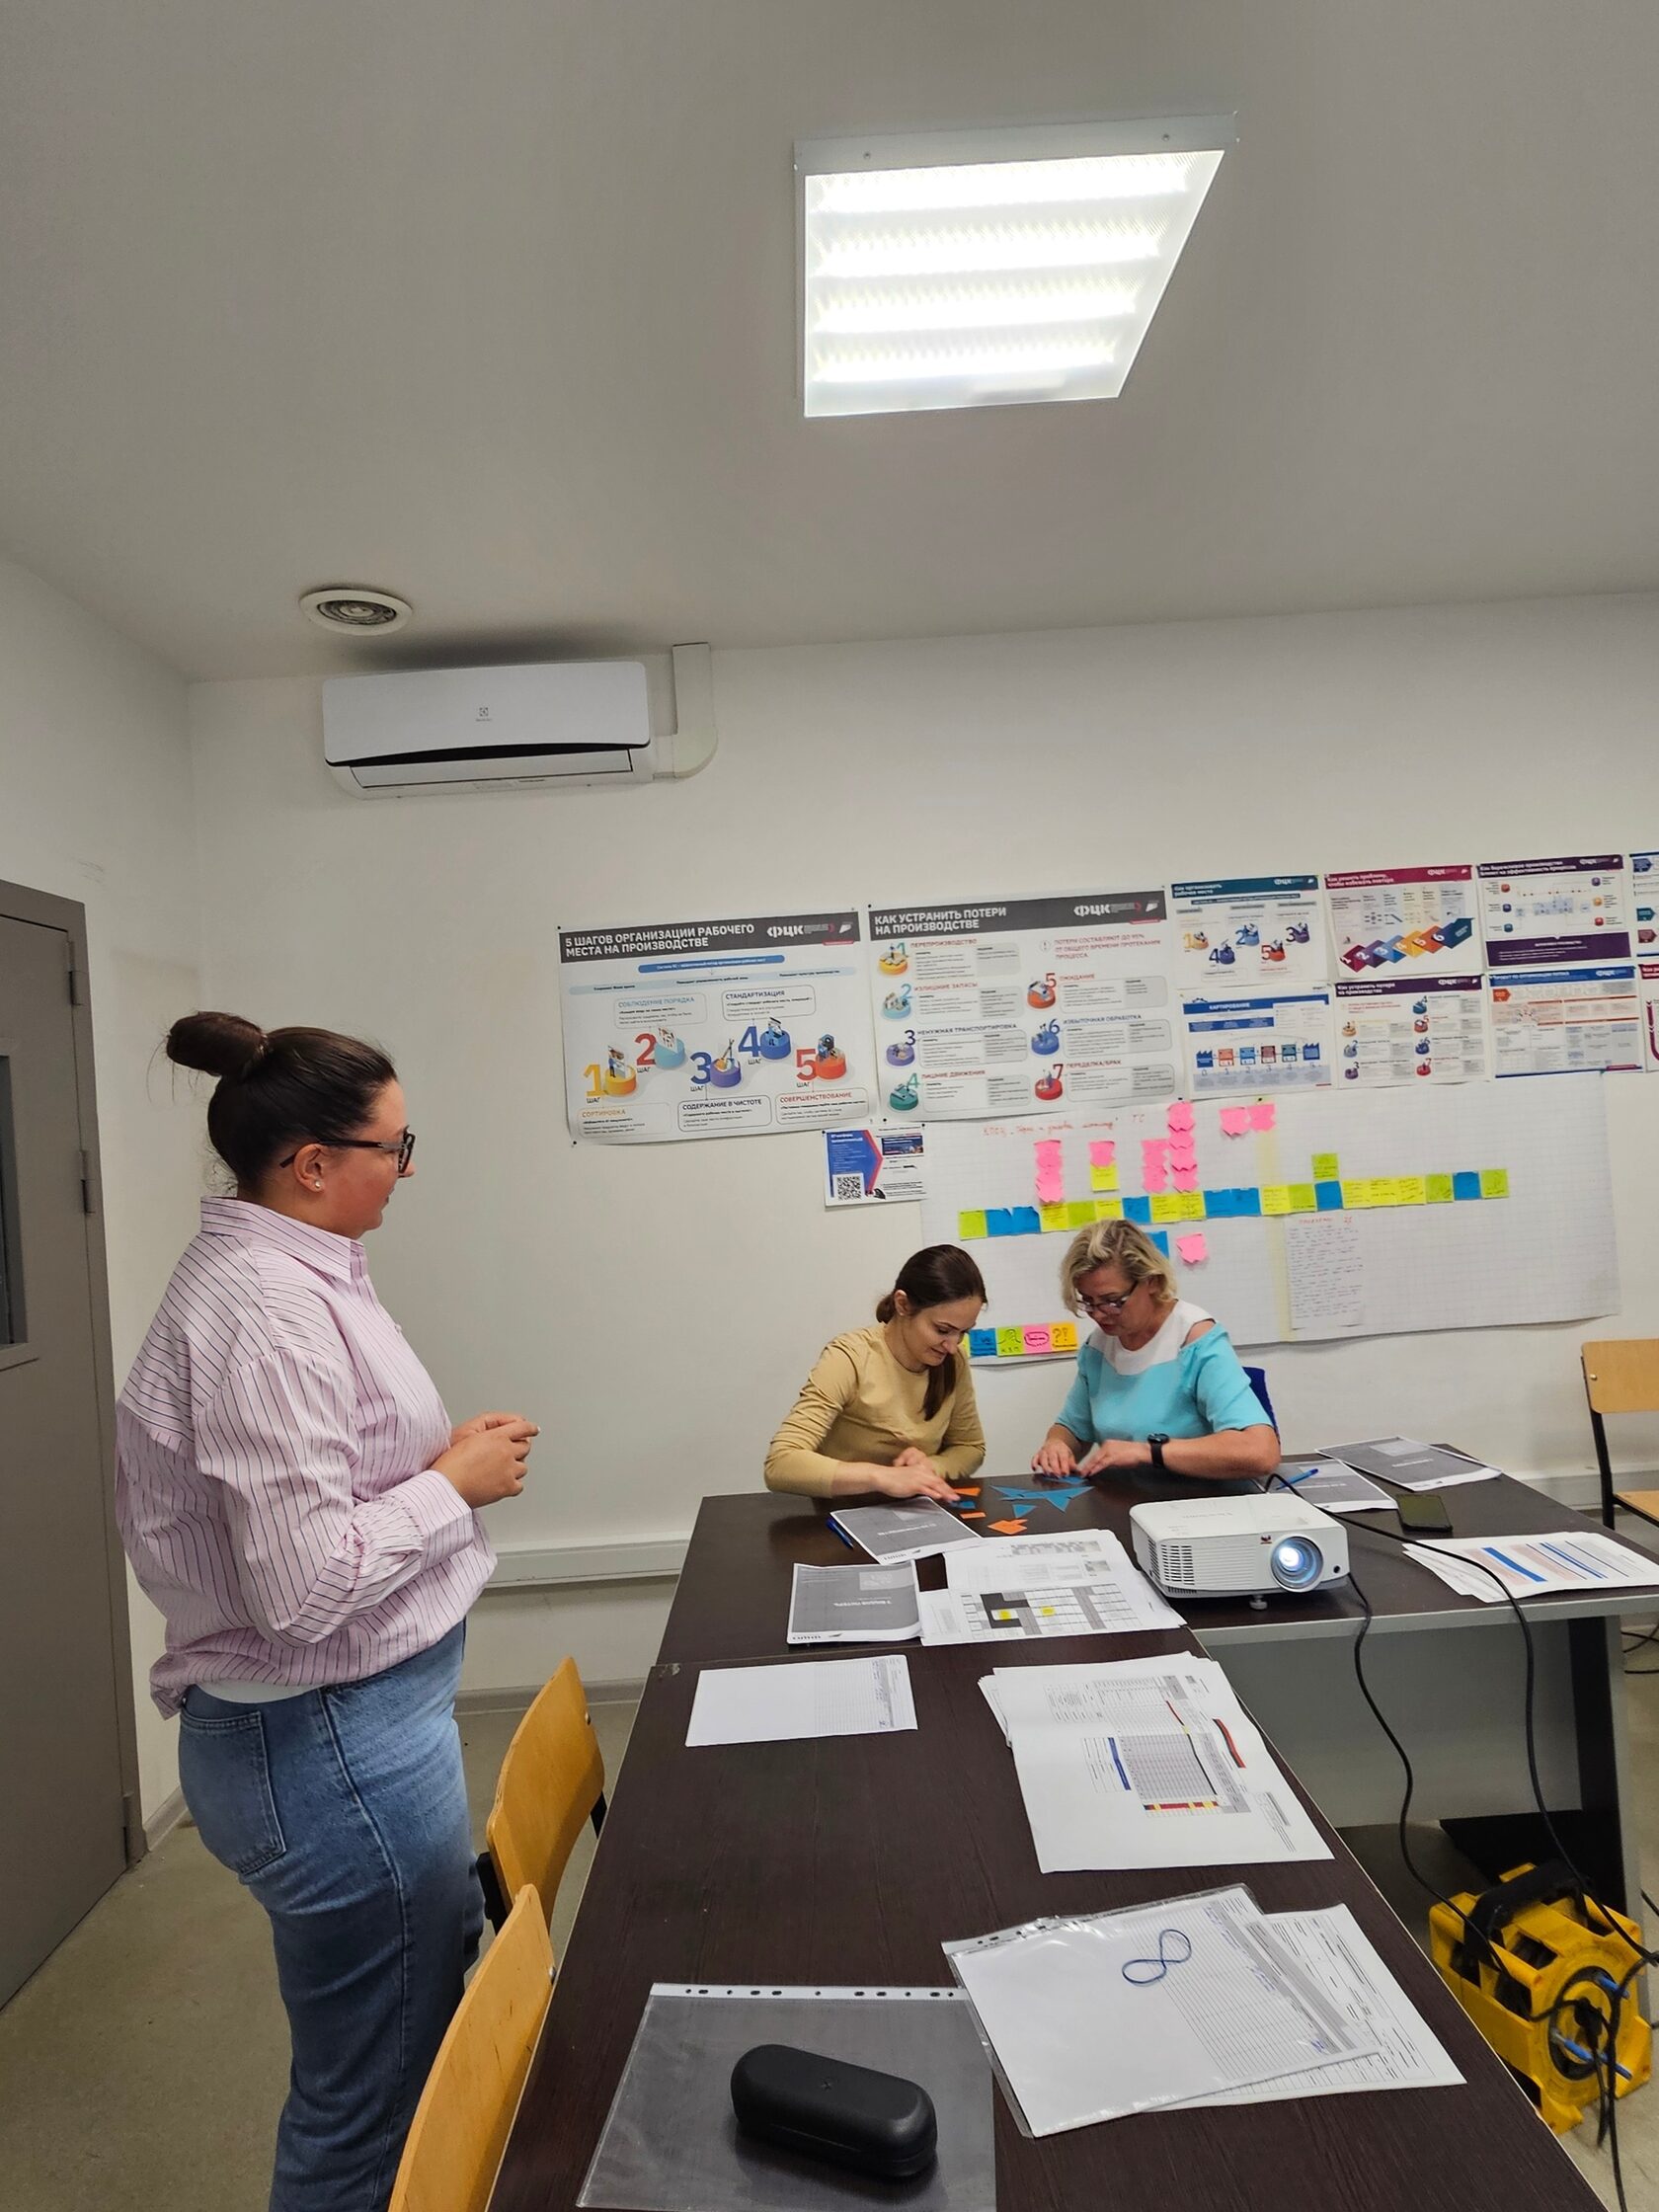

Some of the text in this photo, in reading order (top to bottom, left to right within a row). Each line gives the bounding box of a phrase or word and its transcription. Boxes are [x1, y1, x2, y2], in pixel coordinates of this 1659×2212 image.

[874, 907, 1006, 925] КАК УСТРАНИТЬ ПОТЕРИ
[1073, 904, 1111, 916] ФЦК
[766, 924, 804, 938] ФЦК
[876, 919, 980, 935] НА ПРОИЗВОДСТВЕ
[1286, 926, 1297, 942] 3
[566, 924, 754, 947] 5 ШАГОВ ОРГАНИЗАЦИИ РАБОЧЕГО
[910, 938, 978, 948] ПЕРЕПРОИЗВОДСТВО
[1183, 933, 1194, 949] 1
[1235, 928, 1246, 945] 2
[1414, 937, 1427, 946] 5
[566, 938, 709, 957] МЕСТА НА ПРОИЗВОДСТВЕ
[897, 942, 908, 958] 1
[1261, 945, 1272, 961] 5
[1209, 948, 1220, 964] 4
[1355, 951, 1370, 961] 2
[1046, 973, 1057, 988] 5
[726, 990, 785, 999] СТАНДАРТИЗАЦИЯ
[901, 984, 913, 999] 2
[618, 996, 695, 1008] СОБЛЮДЕНИЕ ПОРЯДКА
[954, 1023, 1017, 1033] ТРАНСПОРТИРОВКА
[1049, 1018, 1061, 1035] 6
[1063, 1016, 1105, 1025] ИЗБЫТОЧНАЯ
[738, 1026, 761, 1058] 4
[905, 1030, 916, 1046] 3
[634, 1033, 658, 1066] 2
[690, 1052, 712, 1084] 3
[796, 1049, 818, 1080] 5
[1053, 1064, 1064, 1079] 7
[584, 1064, 608, 1096] 1
[908, 1072, 920, 1088] 4
[949, 1069, 986, 1078] ДВИЖЕНИЯ
[682, 1101, 727, 1110] СОДЕРЖАНИЕ
[780, 1092, 852, 1103] СОВЕРШЕНСТВОВАНИЕ
[582, 1109, 626, 1118] СОРТИРОВКА
